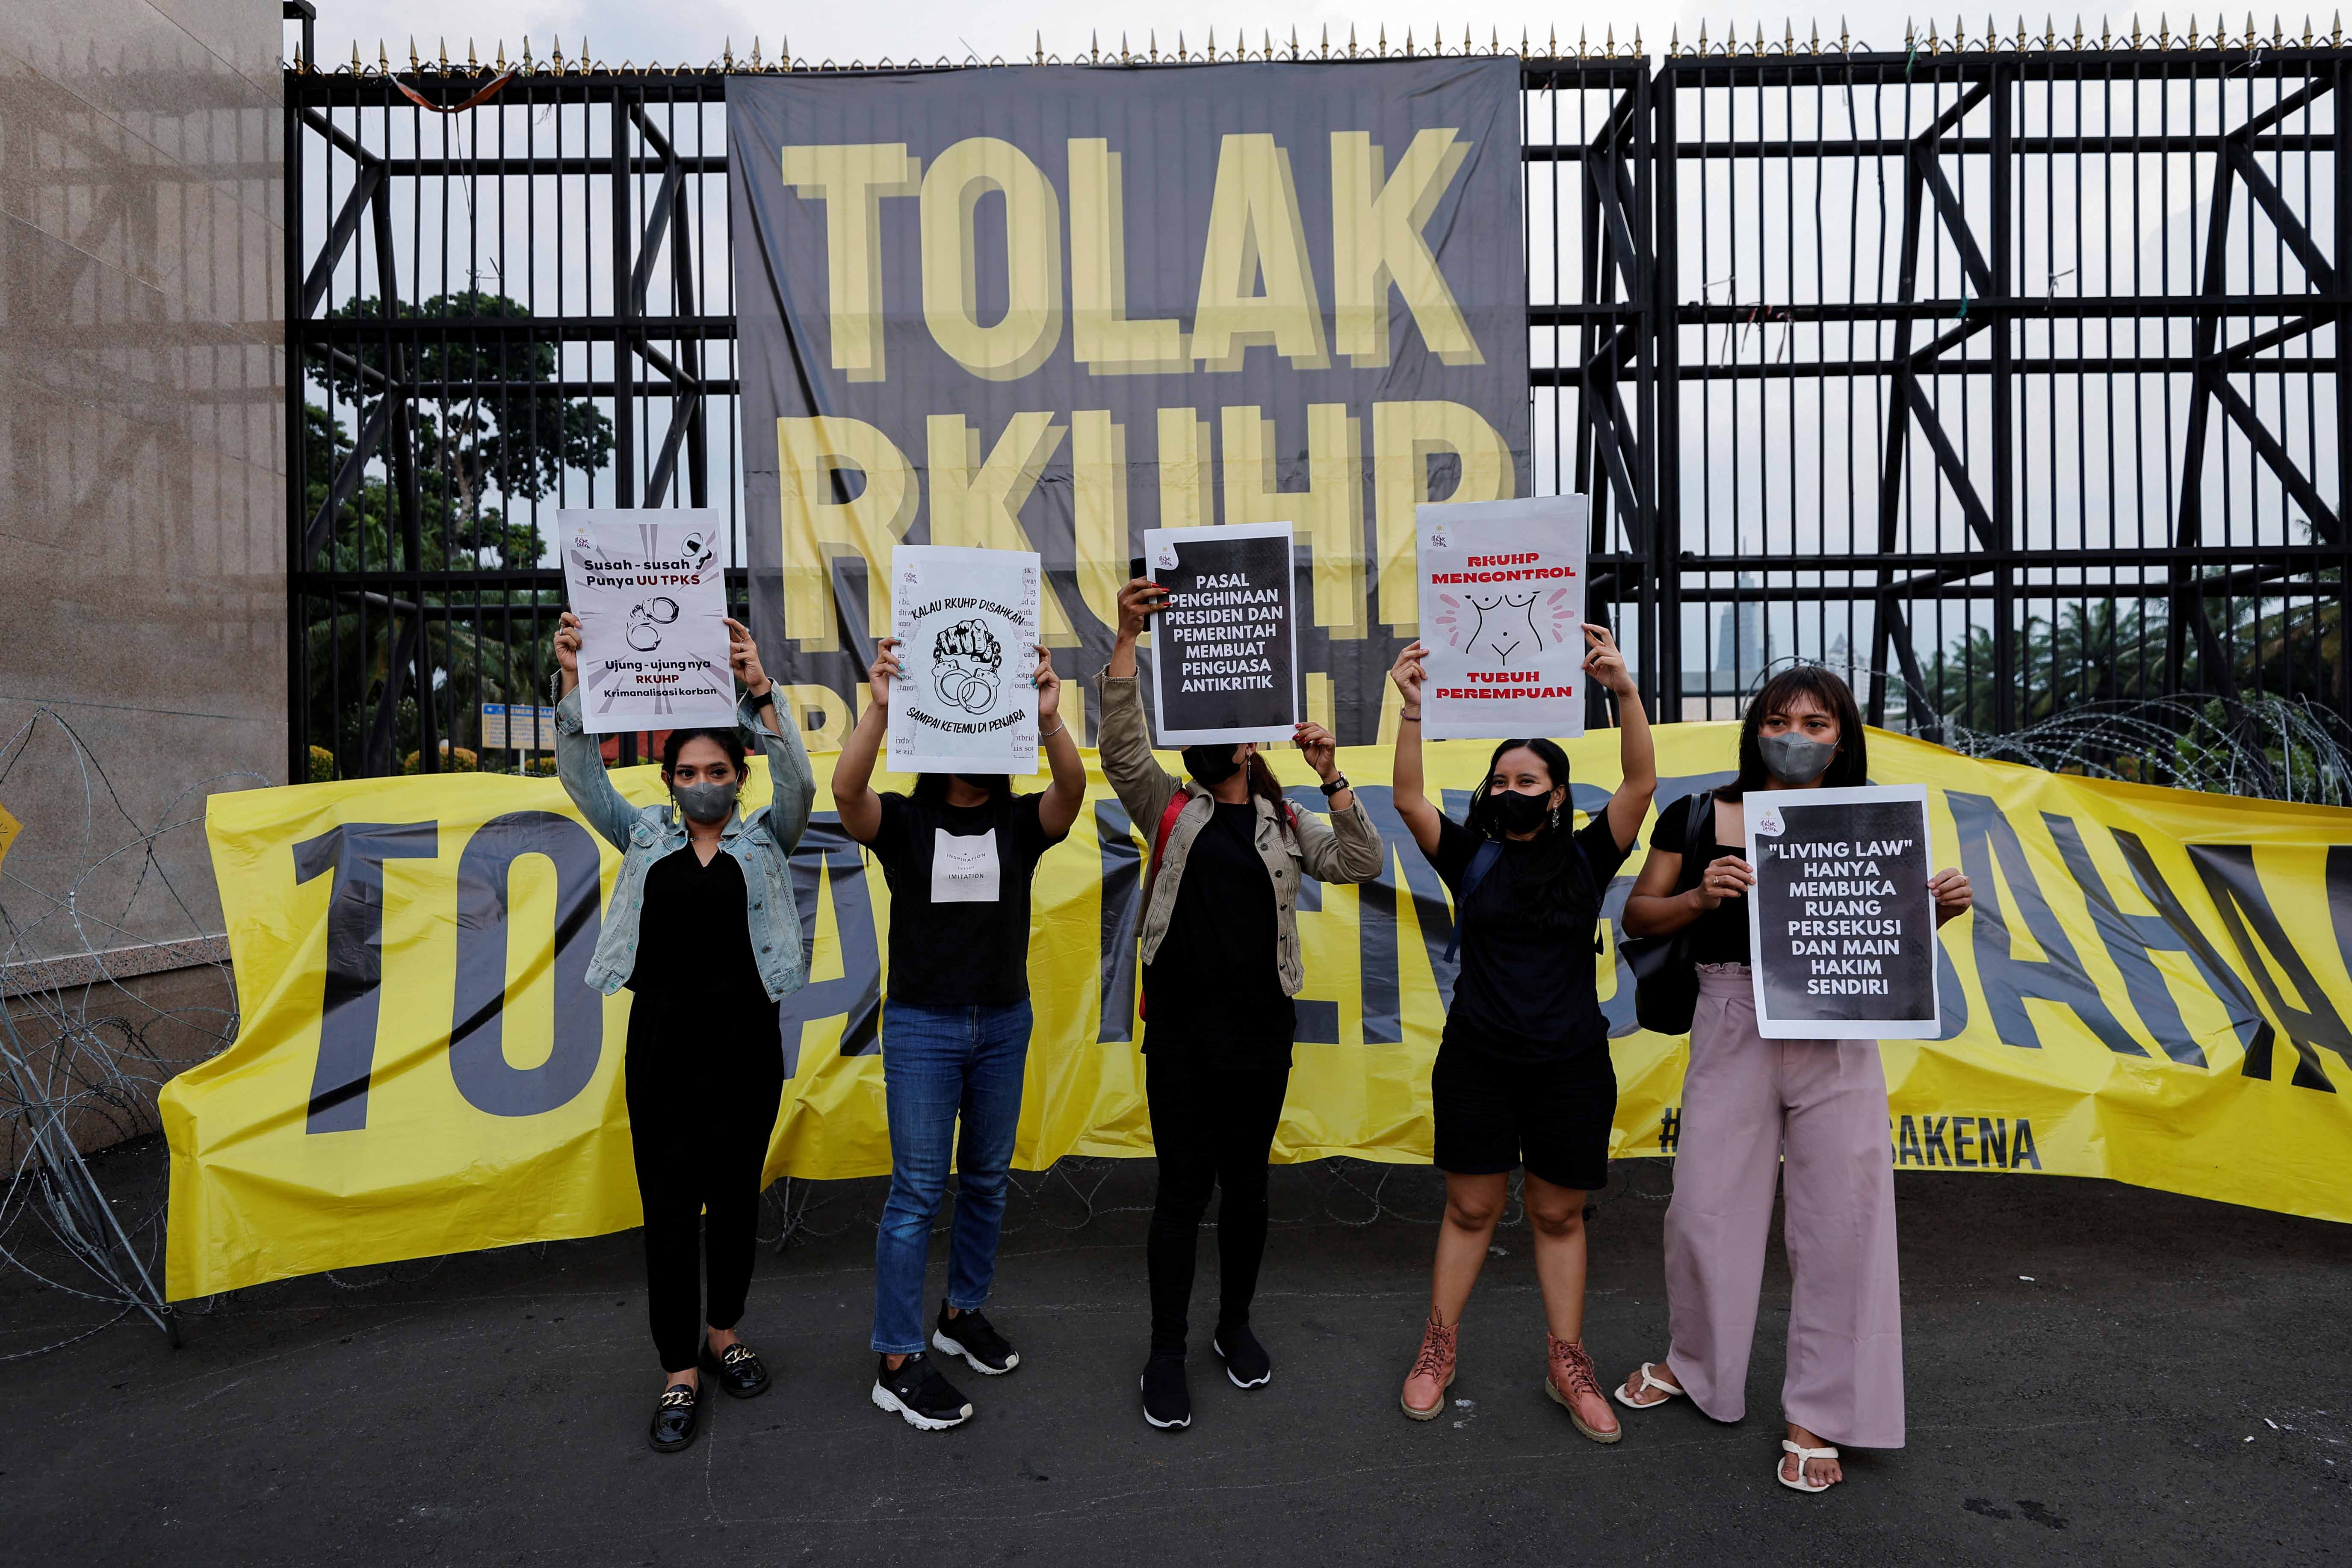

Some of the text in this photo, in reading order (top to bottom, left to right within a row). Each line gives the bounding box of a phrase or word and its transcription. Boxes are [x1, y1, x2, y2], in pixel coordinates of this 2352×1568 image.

[781, 127, 1486, 382] TOLAK
[584, 560, 632, 570] Susah
[644, 559, 690, 570] susah
[1467, 552, 1539, 567] RKUHP
[587, 575, 700, 589] Punya UU TPKS
[1196, 573, 1249, 589] PASAL
[1432, 567, 1576, 584] MENGONTROL
[1169, 588, 1278, 607] PENGHINAAN
[911, 598, 1024, 626] KALAU RKUHP DISAHKAN
[1165, 606, 1283, 625] PRESIDEN DAN
[1173, 623, 1276, 642] PEMERINTAH
[1186, 641, 1265, 659] MEMBUAT
[1182, 659, 1272, 676] PENGUASA
[636, 674, 680, 684] RKUHP
[1181, 675, 1274, 692] ANTIKRITIK
[1466, 671, 1539, 683] TUBUH
[604, 687, 717, 698] Krimanalisasi korban
[1436, 686, 1572, 699] PEREMPUAN
[906, 707, 1026, 734] SAMPAI KETEMU DI PENJARA
[1769, 839, 1912, 859] "LIVING LAW"
[947, 853, 986, 862] INSPIRATION
[1804, 861, 1880, 877] HANYA
[1789, 880, 1897, 897] MEMBUKA
[1805, 900, 1881, 916] RUANG
[1788, 920, 1901, 936] PERSEKUSI
[1792, 940, 1900, 955] DAN MAIN
[1811, 960, 1881, 974] HAKIM
[1807, 979, 1888, 995] SENDIRI
